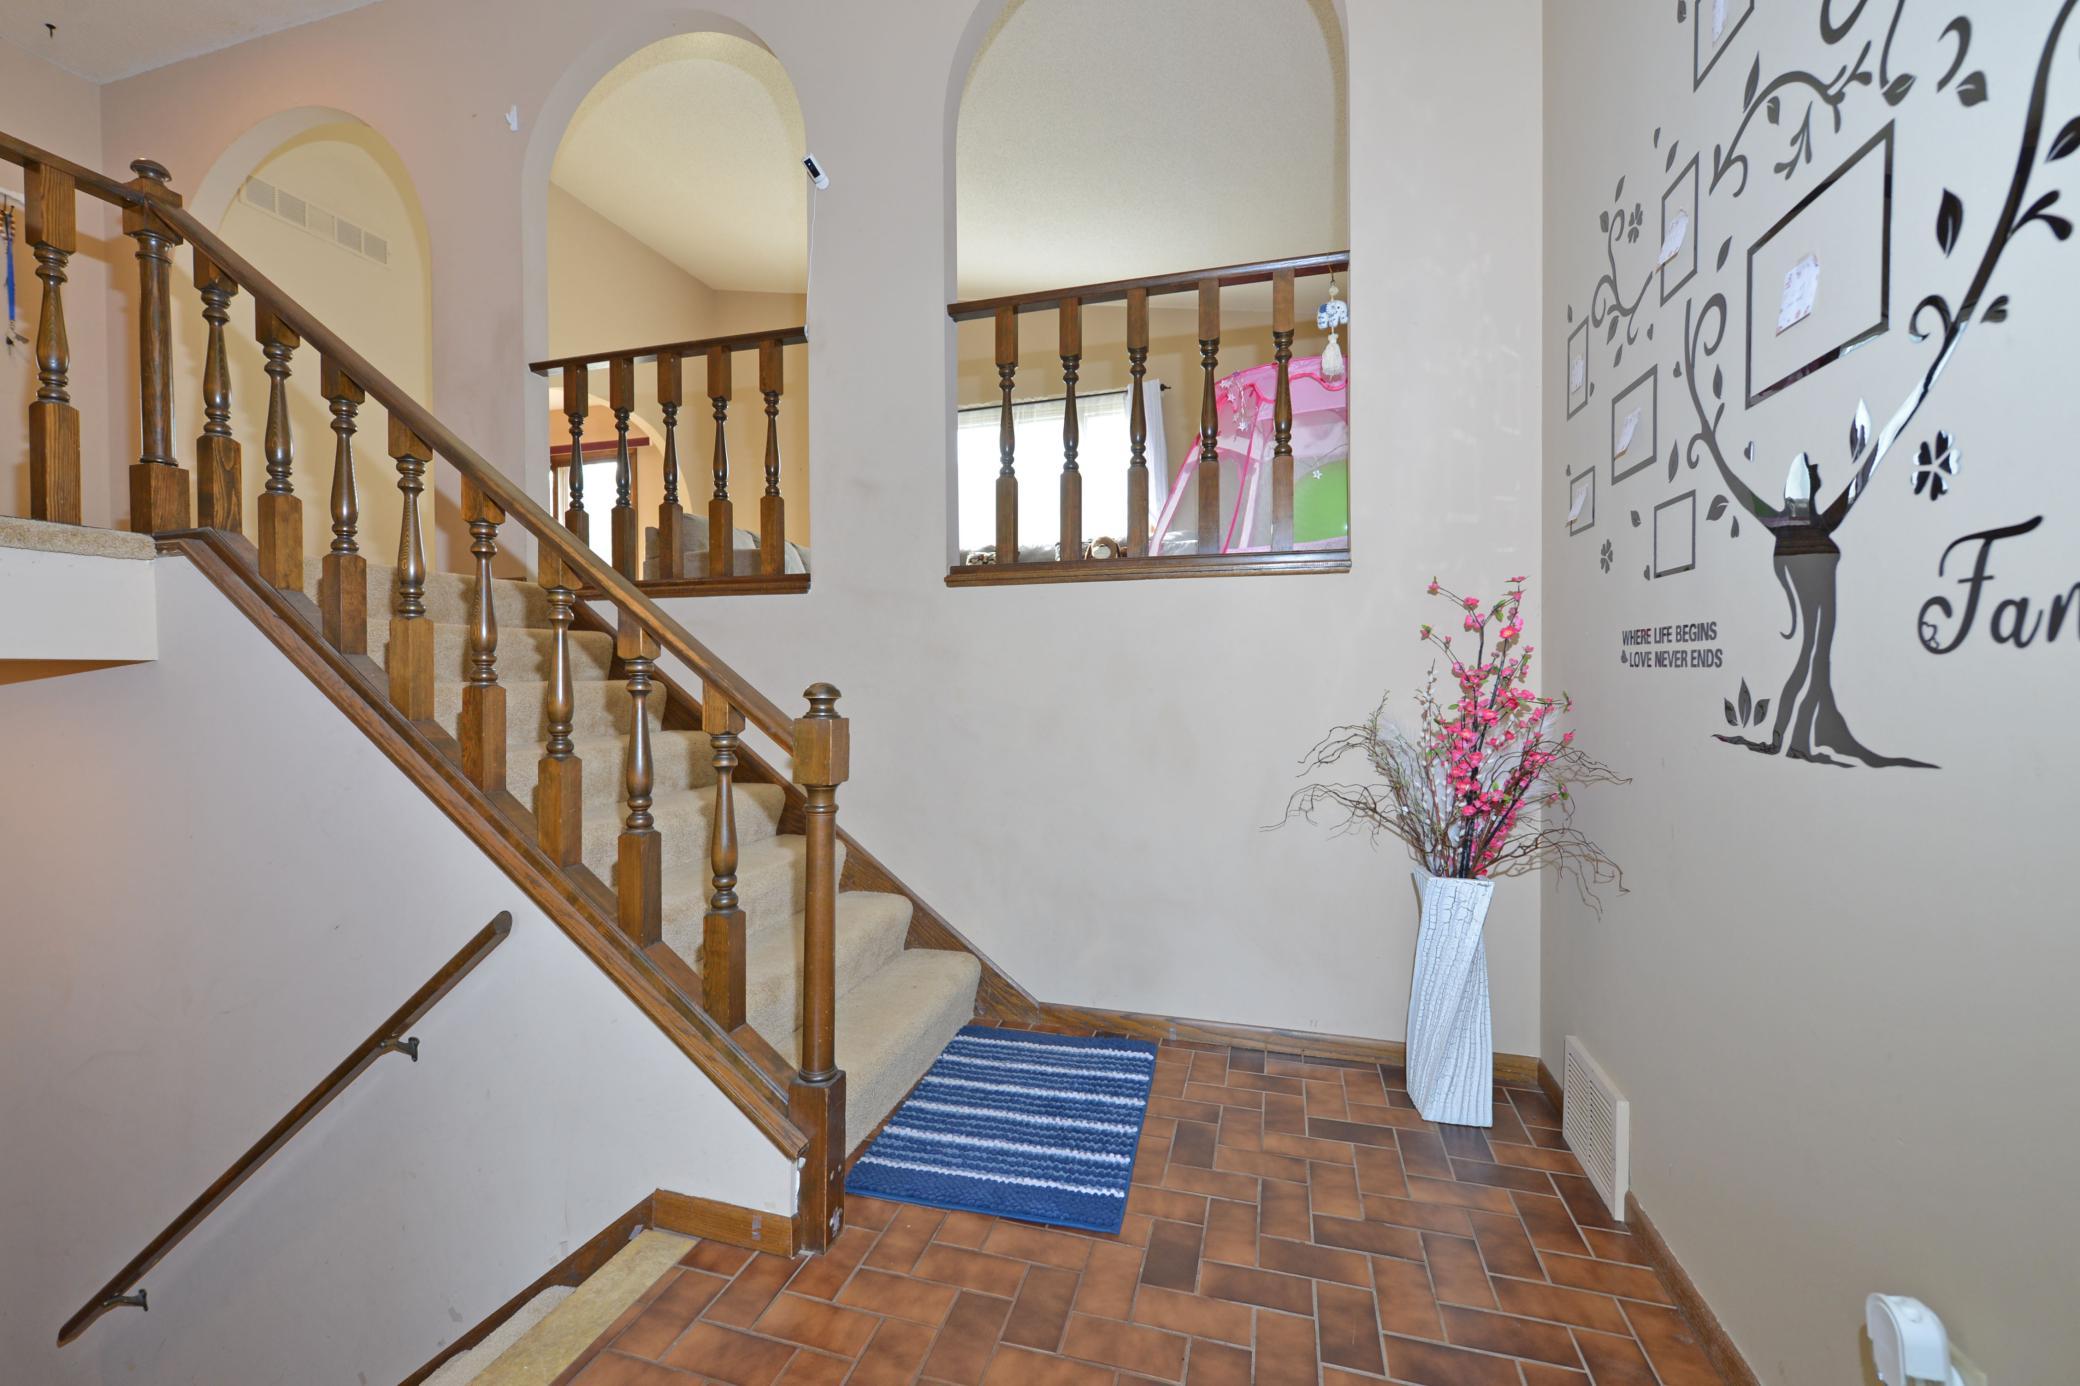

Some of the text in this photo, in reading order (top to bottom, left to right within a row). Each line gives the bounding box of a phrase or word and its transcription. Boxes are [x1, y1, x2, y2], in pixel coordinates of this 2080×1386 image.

[1622, 621, 1717, 646] WHERE LIFE BEGINS
[1629, 648, 1723, 668] LOVE NEVER ENDS
